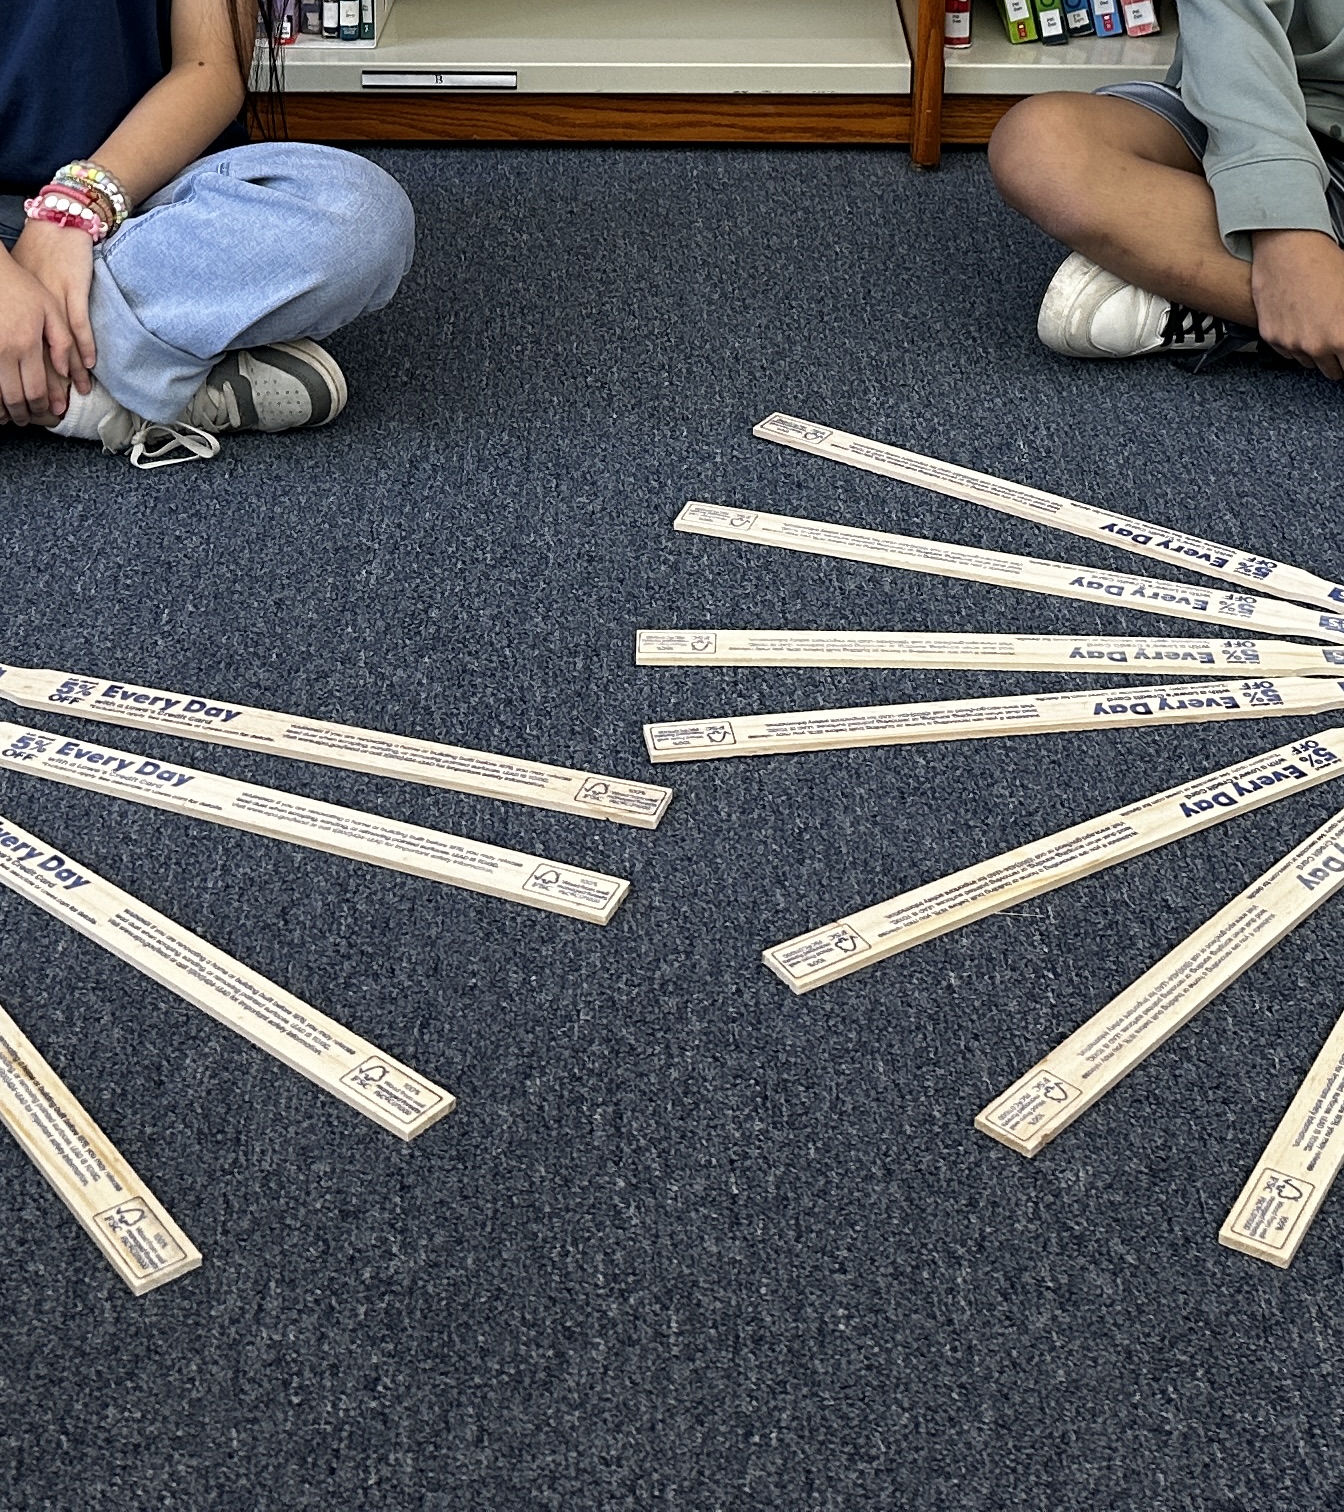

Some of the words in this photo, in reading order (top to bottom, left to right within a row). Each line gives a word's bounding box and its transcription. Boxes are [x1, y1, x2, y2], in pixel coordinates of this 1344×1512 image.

[434, 73, 444, 85] B
[55, 740, 132, 777] Every
[135, 761, 197, 788] Day
[38, 854, 92, 891] Day
